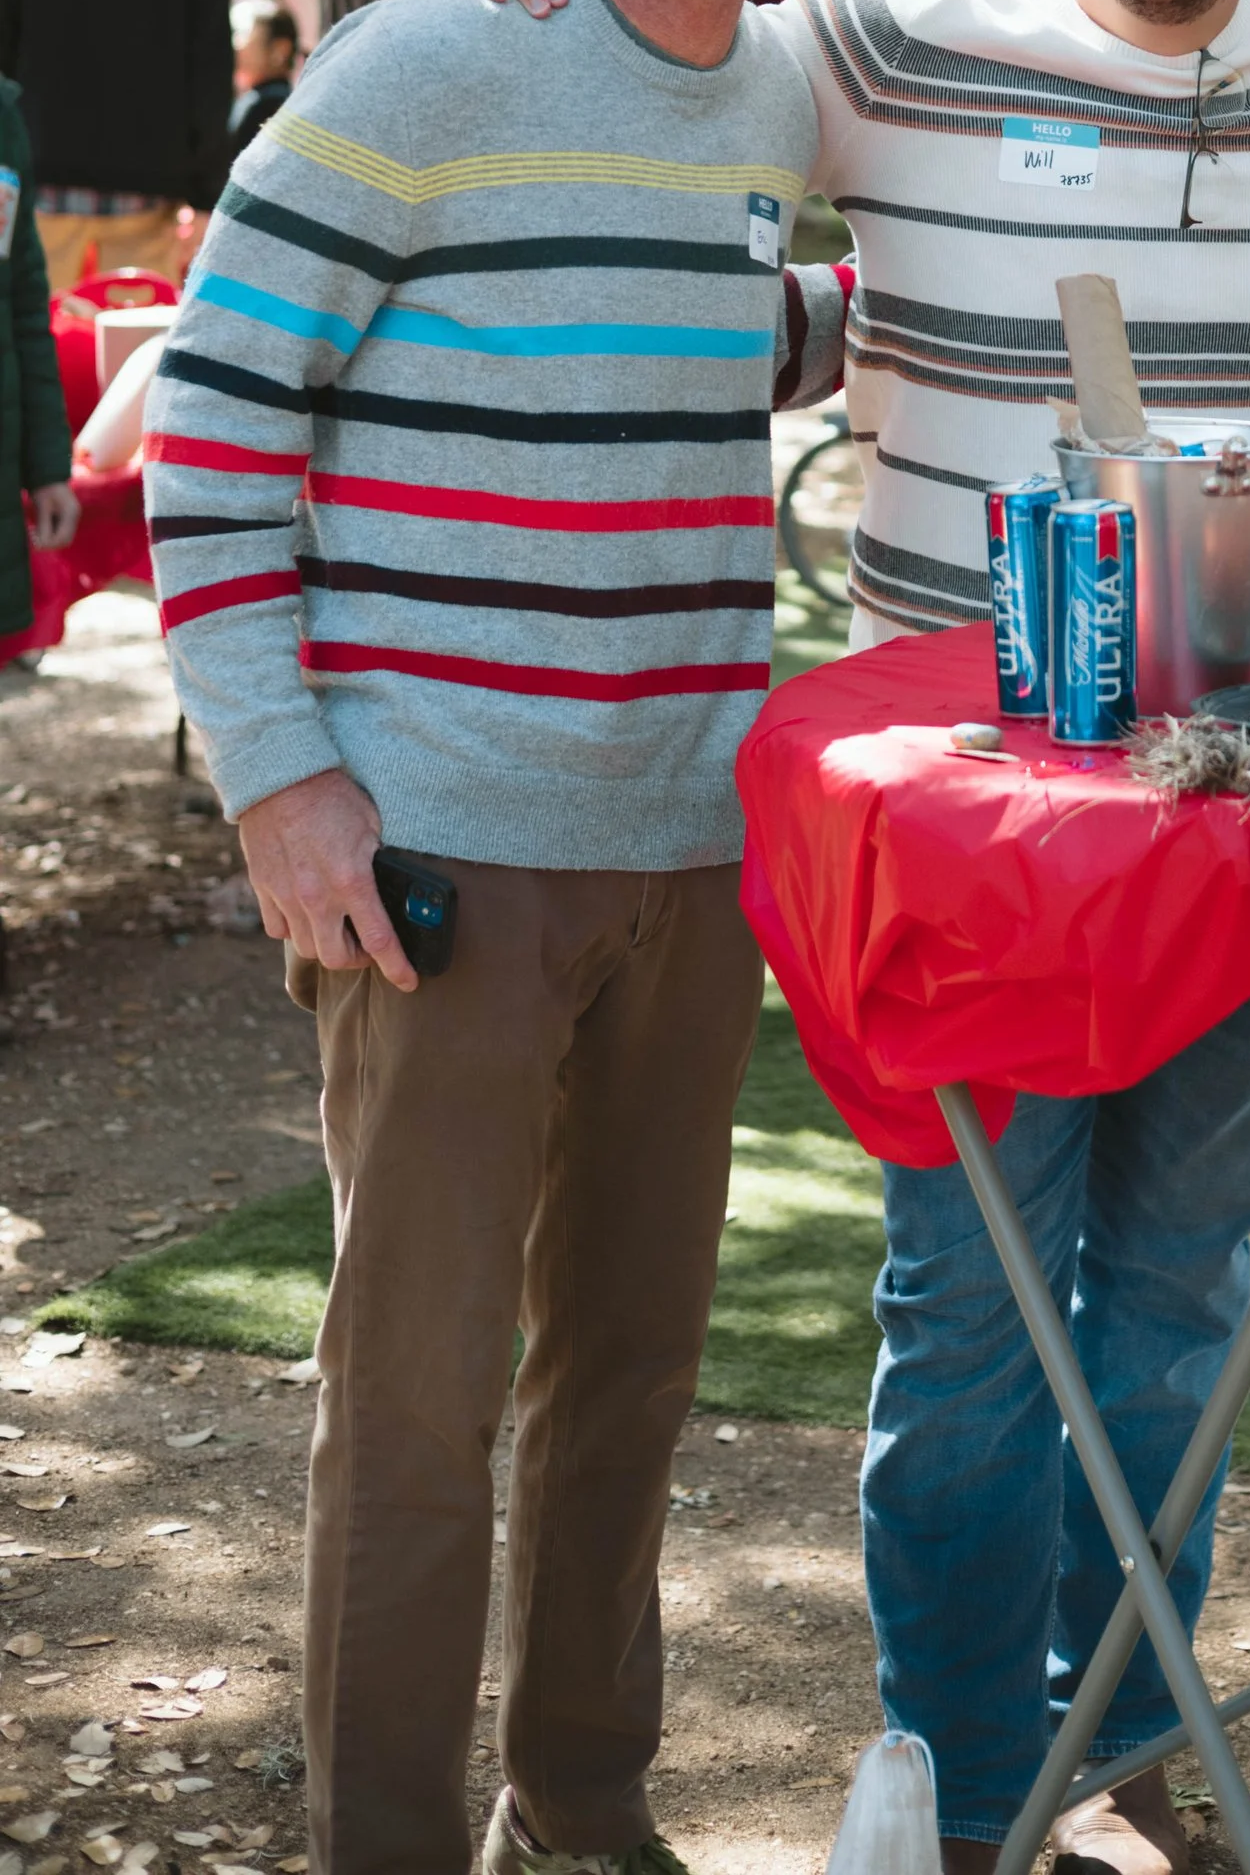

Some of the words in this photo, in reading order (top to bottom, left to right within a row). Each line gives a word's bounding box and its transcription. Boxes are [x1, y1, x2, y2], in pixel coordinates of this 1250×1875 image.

[1032, 122, 1072, 137] HELLO
[1024, 149, 1054, 169] Will
[1060, 172, 1094, 186] 78735
[991, 552, 1019, 676] ULTRA
[1095, 571, 1123, 702] ULTRA
